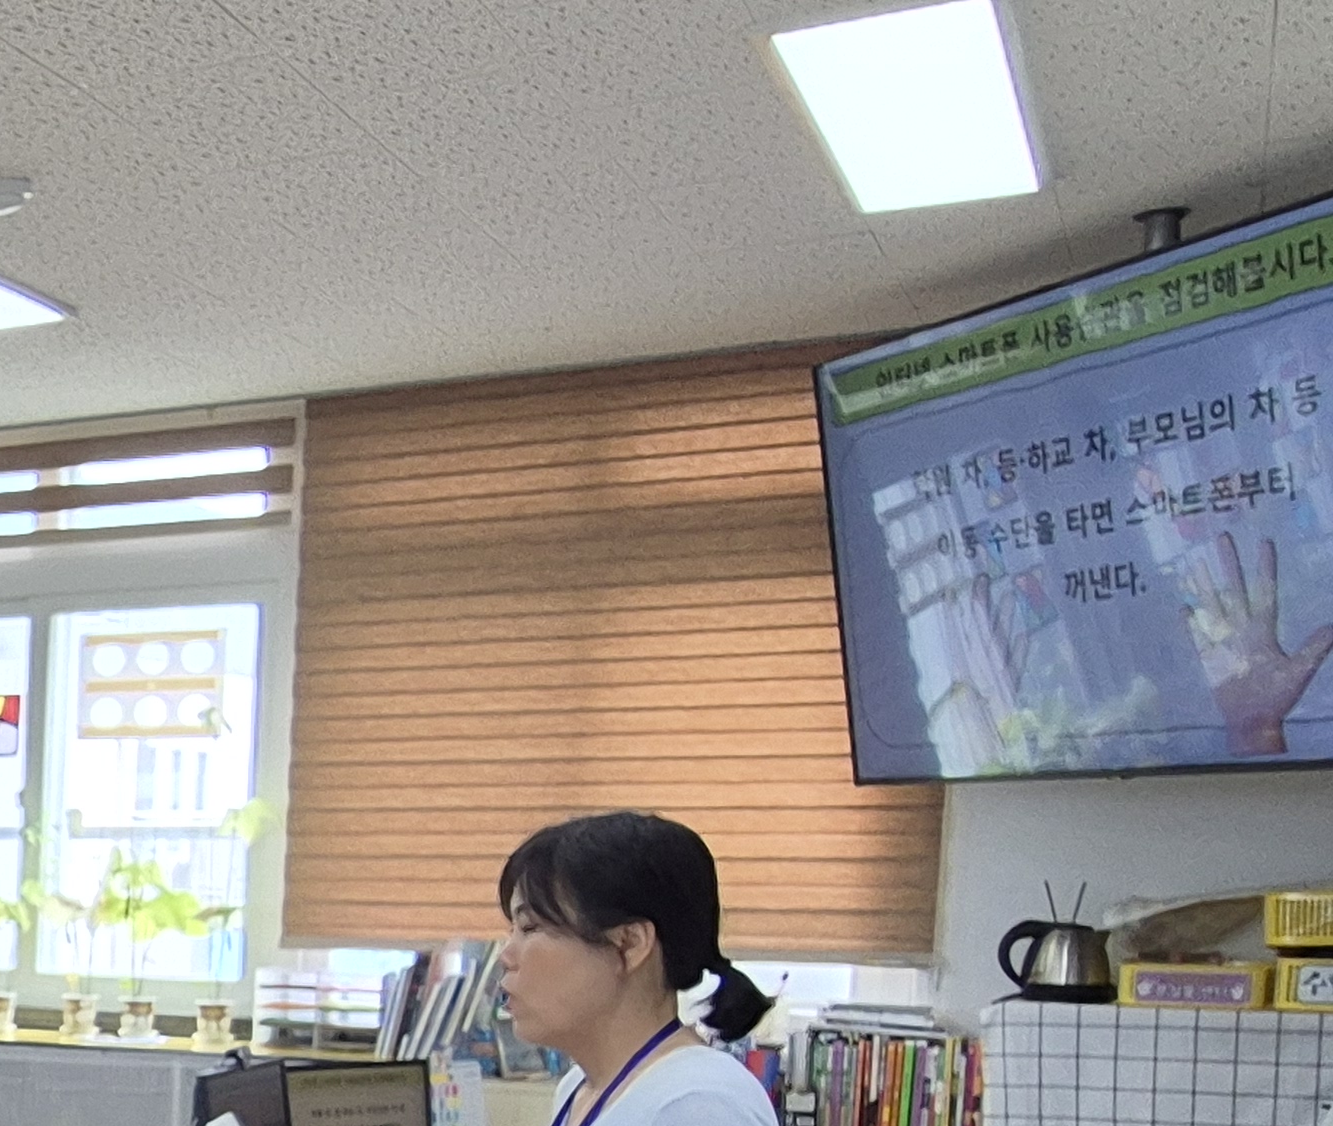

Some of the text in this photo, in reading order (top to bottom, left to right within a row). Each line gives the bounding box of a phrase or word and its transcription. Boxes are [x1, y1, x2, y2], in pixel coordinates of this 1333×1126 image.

[1083, 426, 1116, 462] 차,
[1127, 394, 1235, 454] 부모님의
[1248, 386, 1277, 424] 차
[1291, 374, 1321, 416] 등
[938, 463, 1296, 559] 이동 수단을 타면 스마트폰부터
[1063, 562, 1147, 602] 꺼낸다.
